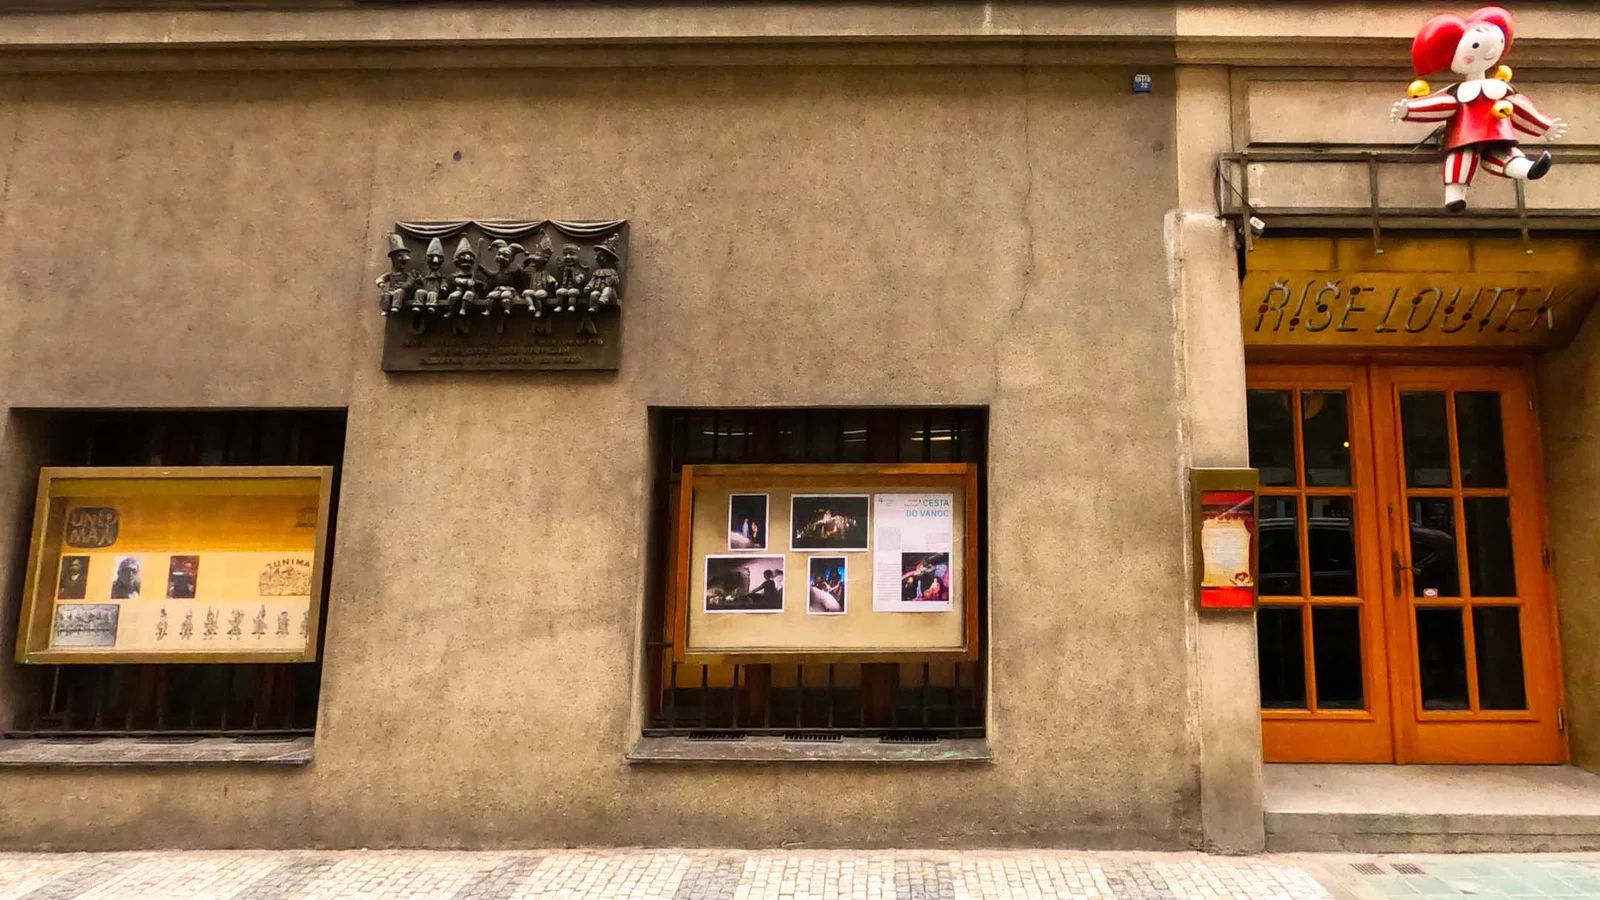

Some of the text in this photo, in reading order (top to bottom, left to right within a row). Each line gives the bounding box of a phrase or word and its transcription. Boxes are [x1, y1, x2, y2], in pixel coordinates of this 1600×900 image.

[1375, 287, 1577, 333] LOUTEK
[922, 499, 950, 507] CESTA
[906, 509, 918, 518] DO
